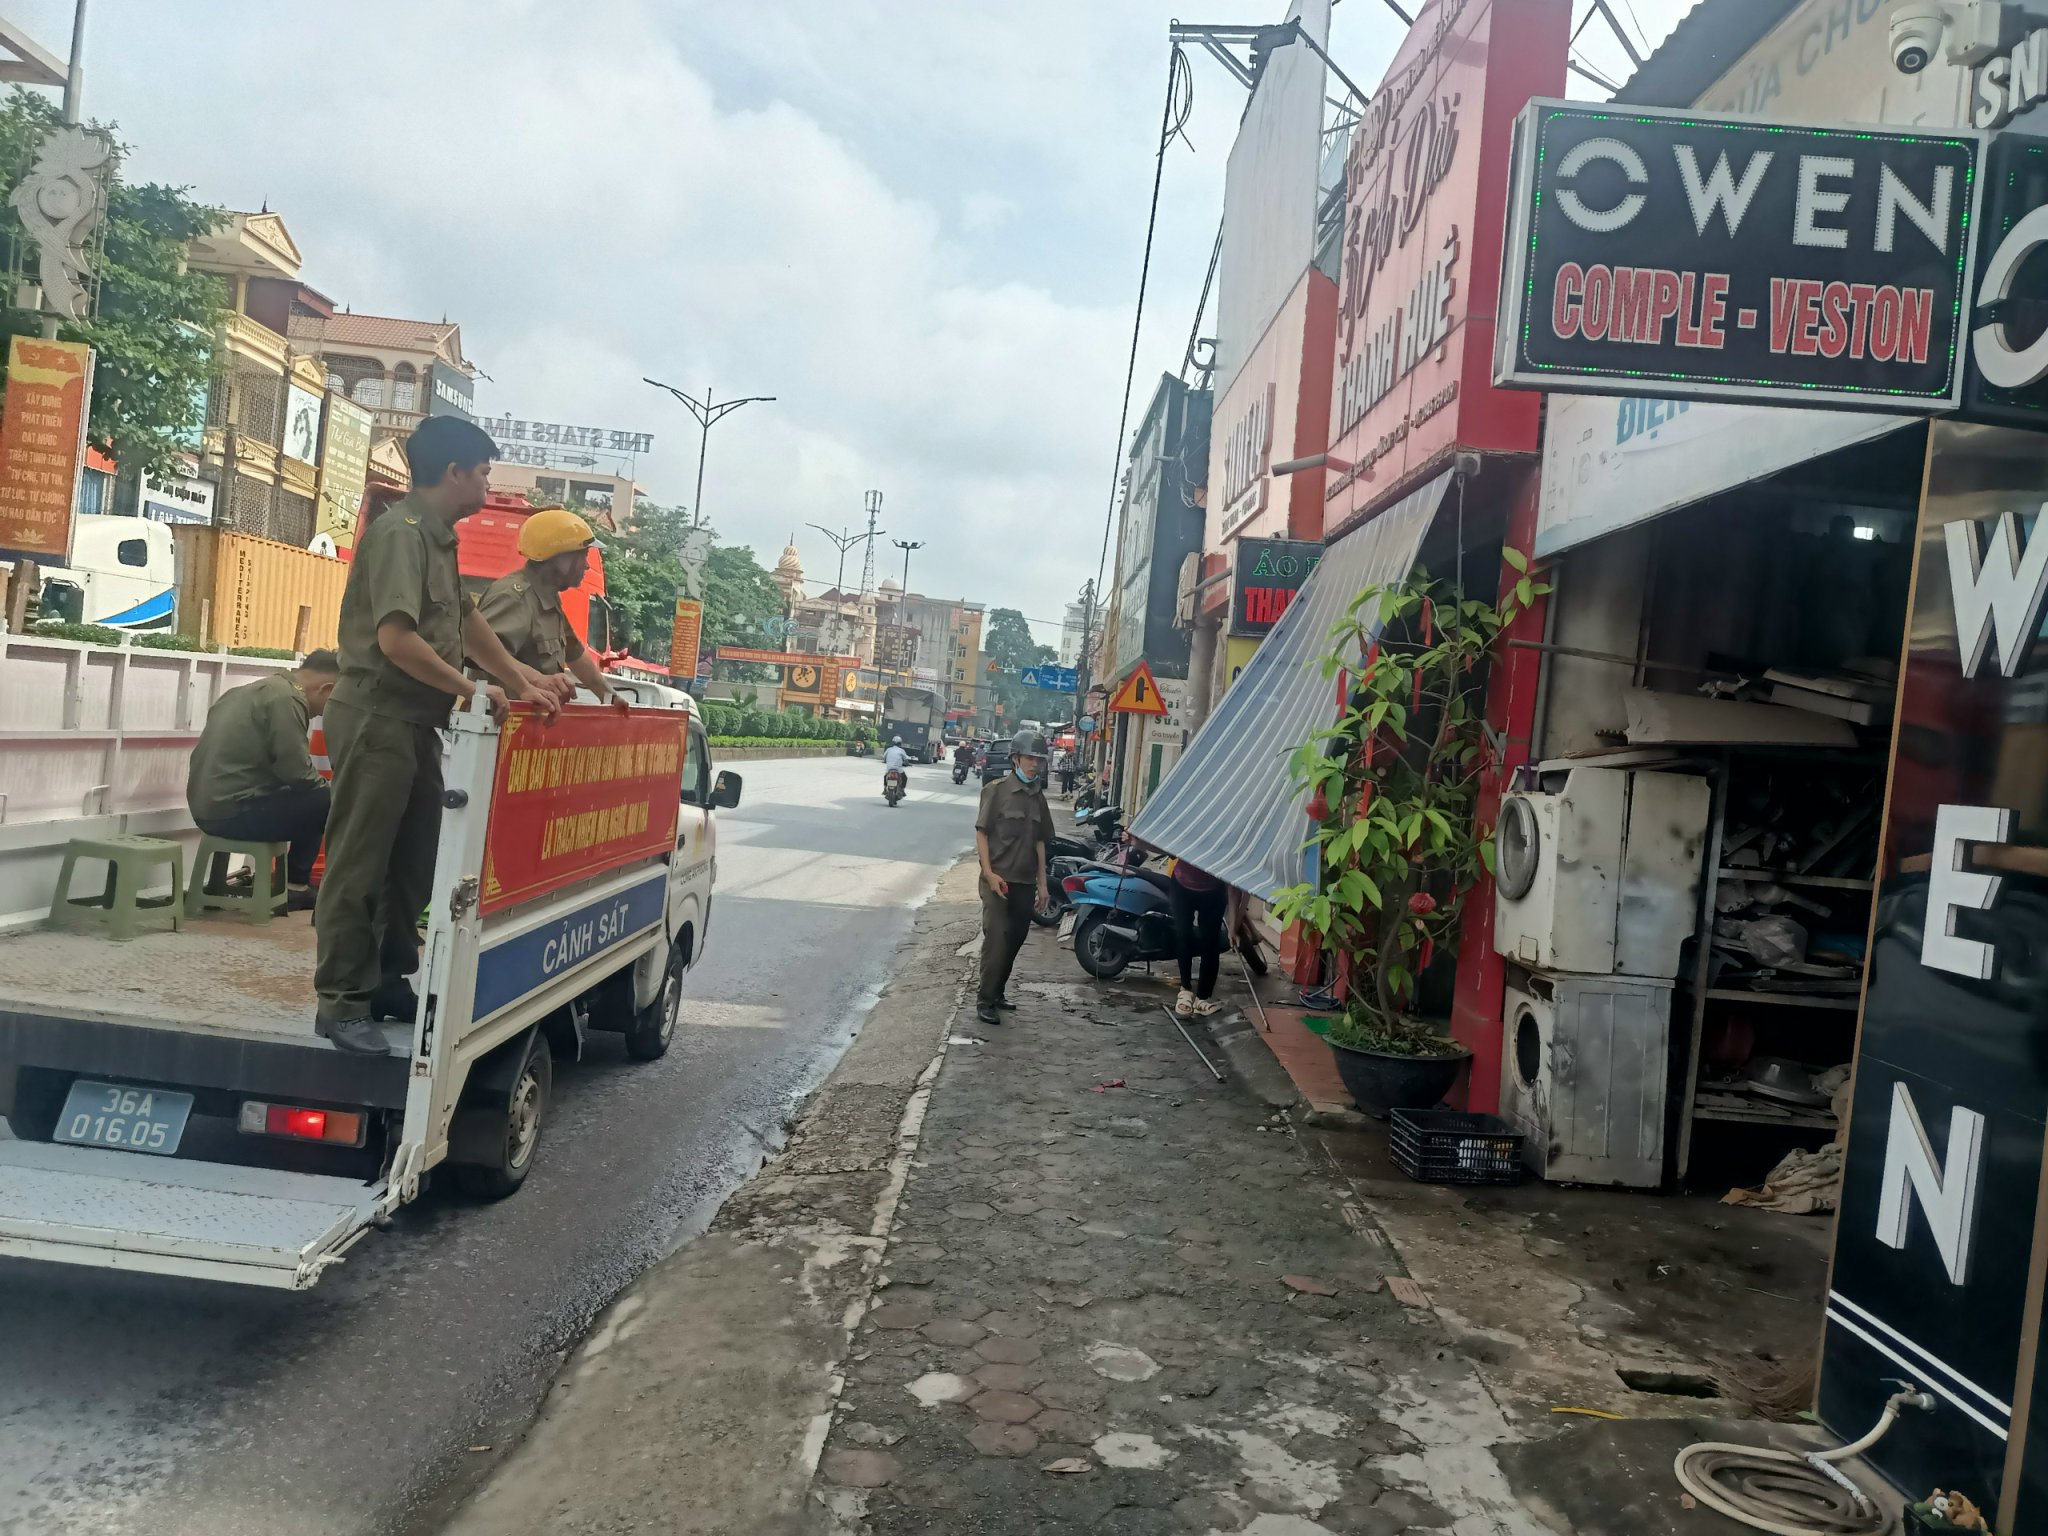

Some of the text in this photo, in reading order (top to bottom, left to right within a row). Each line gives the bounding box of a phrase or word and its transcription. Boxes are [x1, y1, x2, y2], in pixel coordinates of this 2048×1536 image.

[1555, 136, 1954, 255] OWEN
[1552, 261, 1730, 350] COMPLE
[1769, 277, 1935, 365] VESTON
[435, 379, 473, 415] SAMSUNG
[1337, 310, 1399, 441] THANH
[191, 490, 206, 504] MÁY
[233, 550, 246, 646] MEDITERRANEAN
[1161, 698, 1180, 709] ai
[542, 900, 629, 974] CẢNH SÁT
[101, 1088, 153, 1117] 36A
[70, 1113, 169, 1148] 016.05
